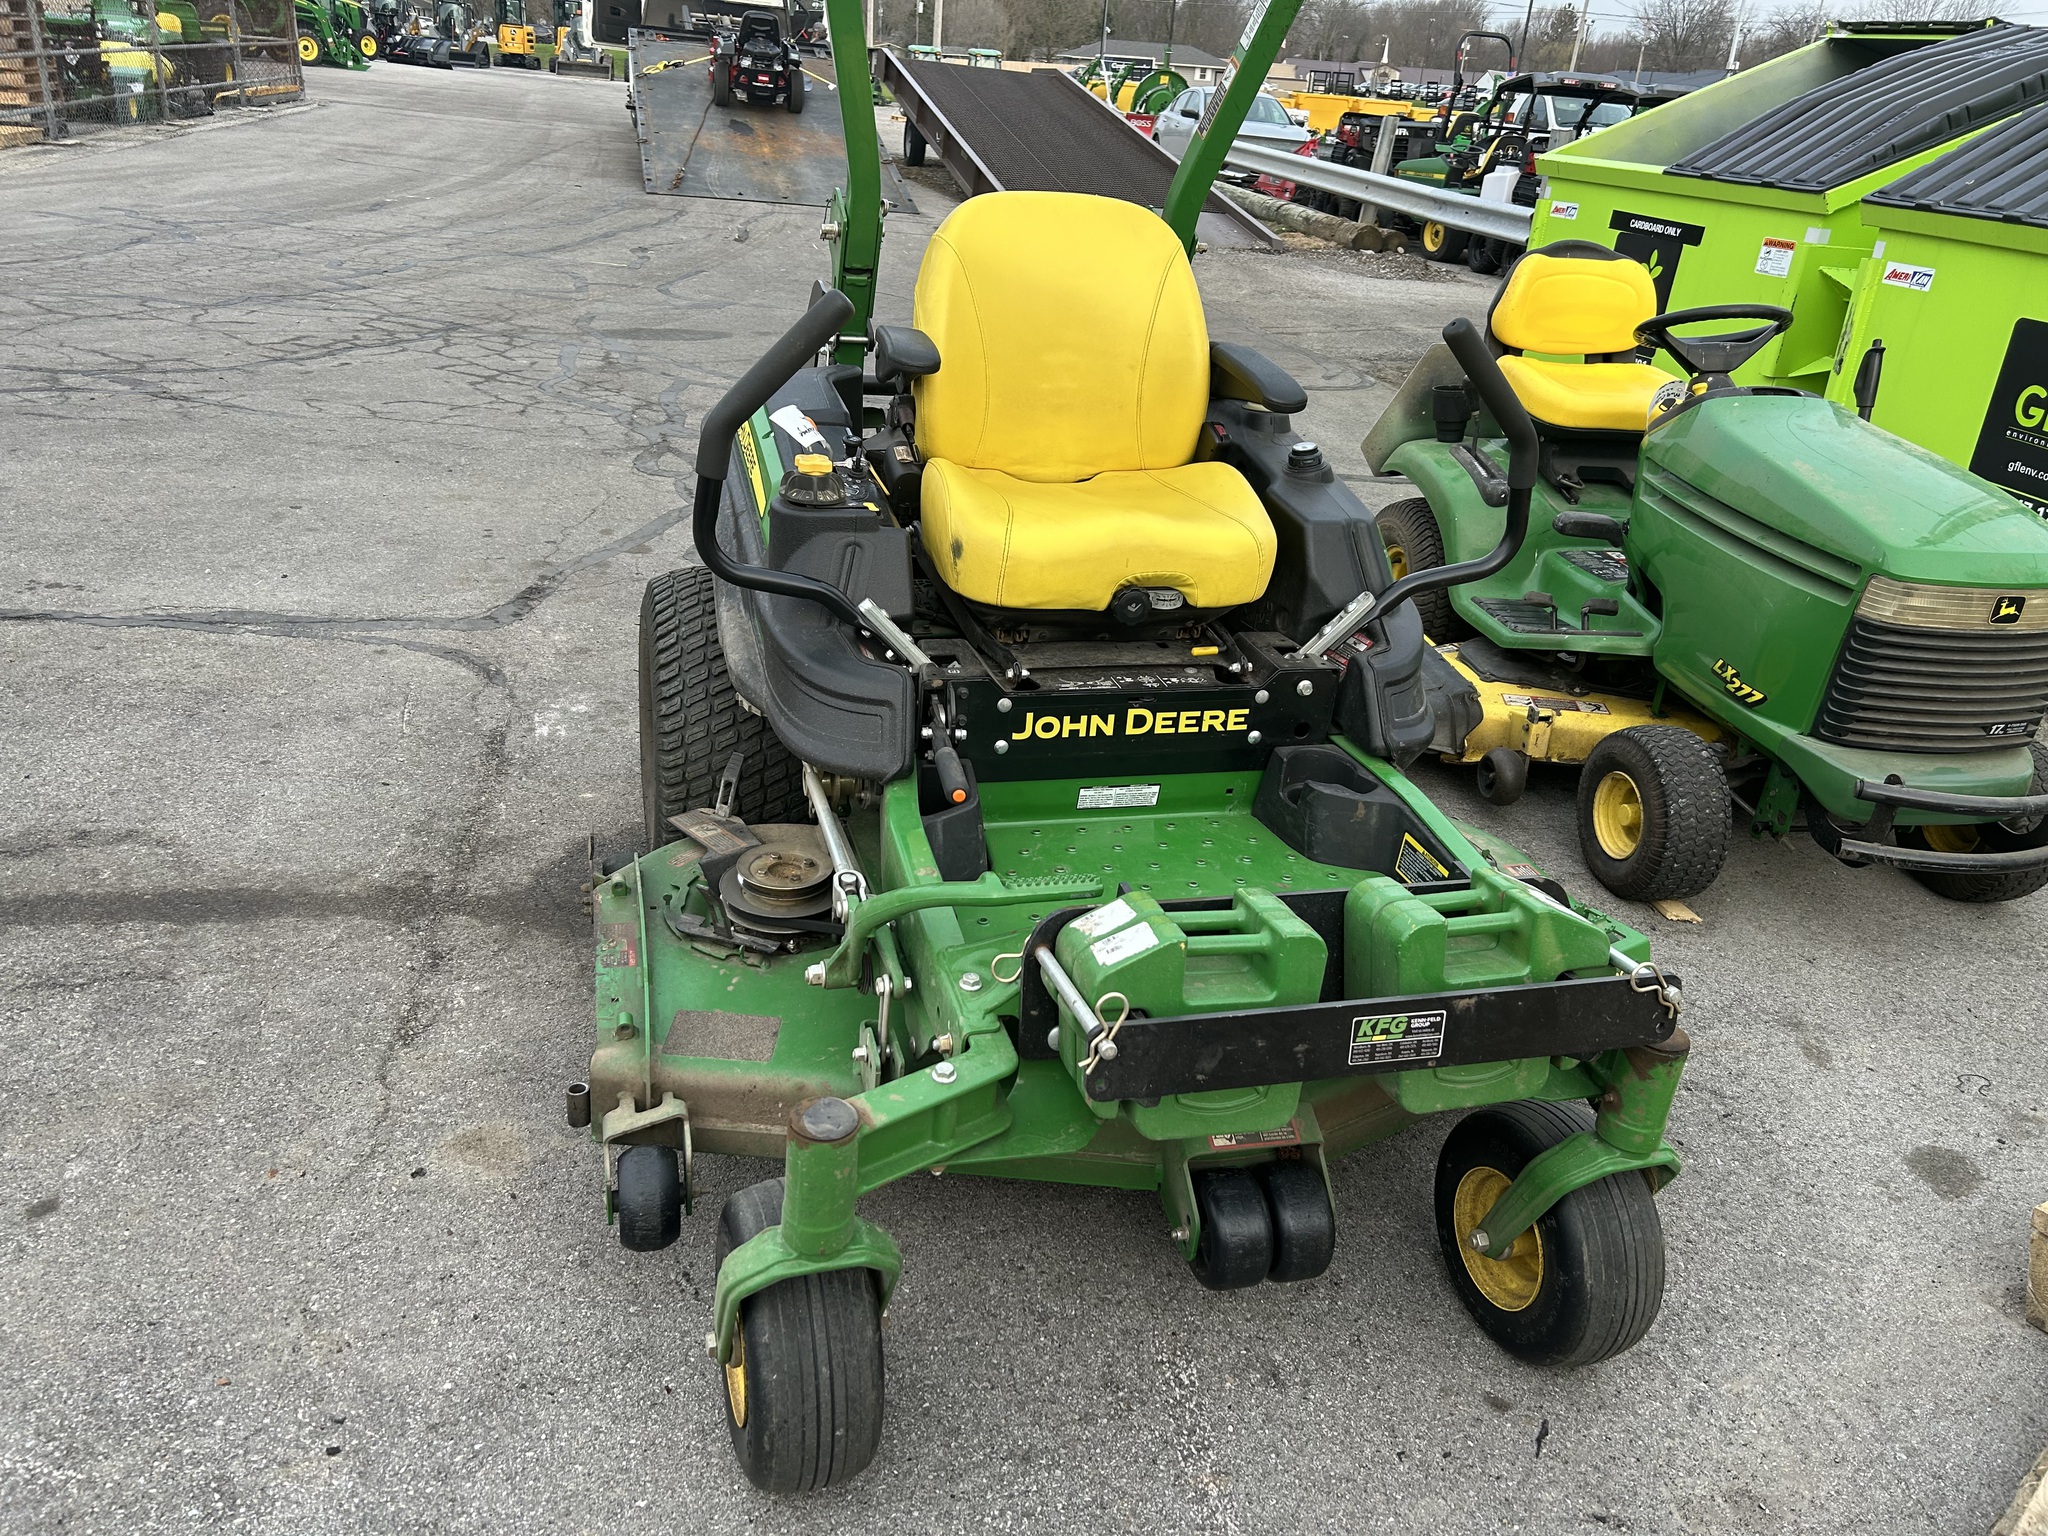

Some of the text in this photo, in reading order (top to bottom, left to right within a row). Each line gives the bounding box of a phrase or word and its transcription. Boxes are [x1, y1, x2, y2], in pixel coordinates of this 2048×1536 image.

[1629, 219, 1682, 237] CARDBOARD ONLY
[1768, 240, 1795, 250] WARNING
[1012, 708, 1250, 740] JOHN DEERE
[1989, 724, 2005, 735] 17
[1357, 1016, 1409, 1037] KFG
[1410, 1016, 1441, 1024] KENN-FELD
